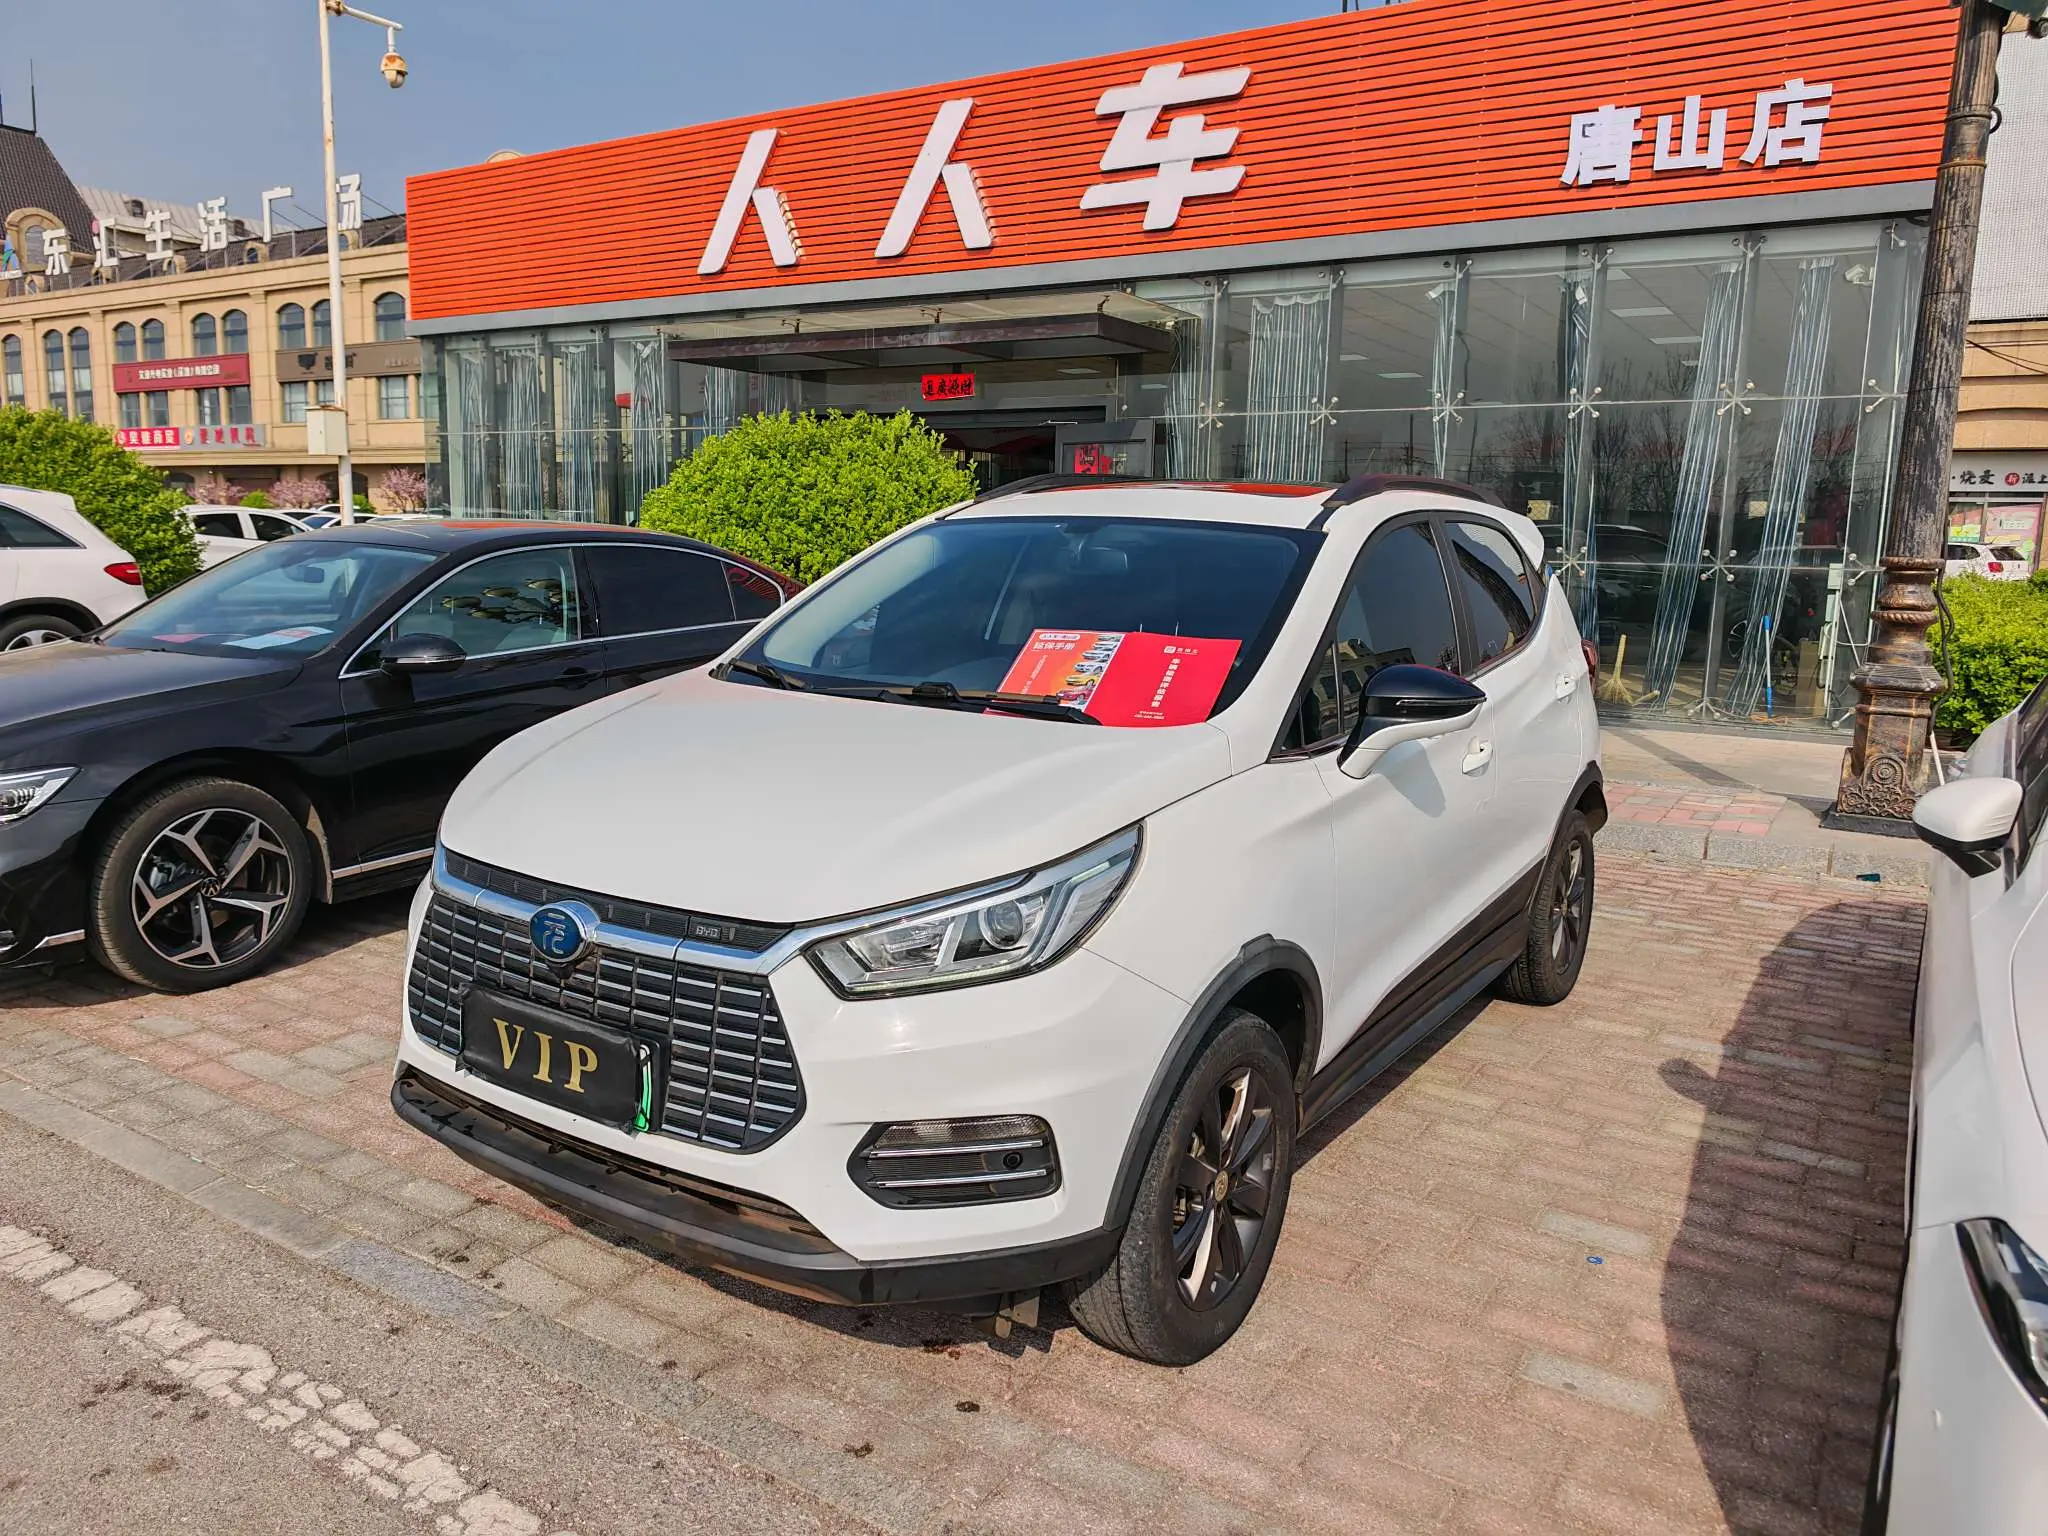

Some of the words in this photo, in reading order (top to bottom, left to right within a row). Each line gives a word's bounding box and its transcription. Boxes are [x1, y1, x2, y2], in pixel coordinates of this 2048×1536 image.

[697, 61, 1253, 275] 人人车
[1559, 77, 1833, 187] 唐山店
[696, 925, 719, 938] BYD
[492, 1017, 599, 1094] VIP
